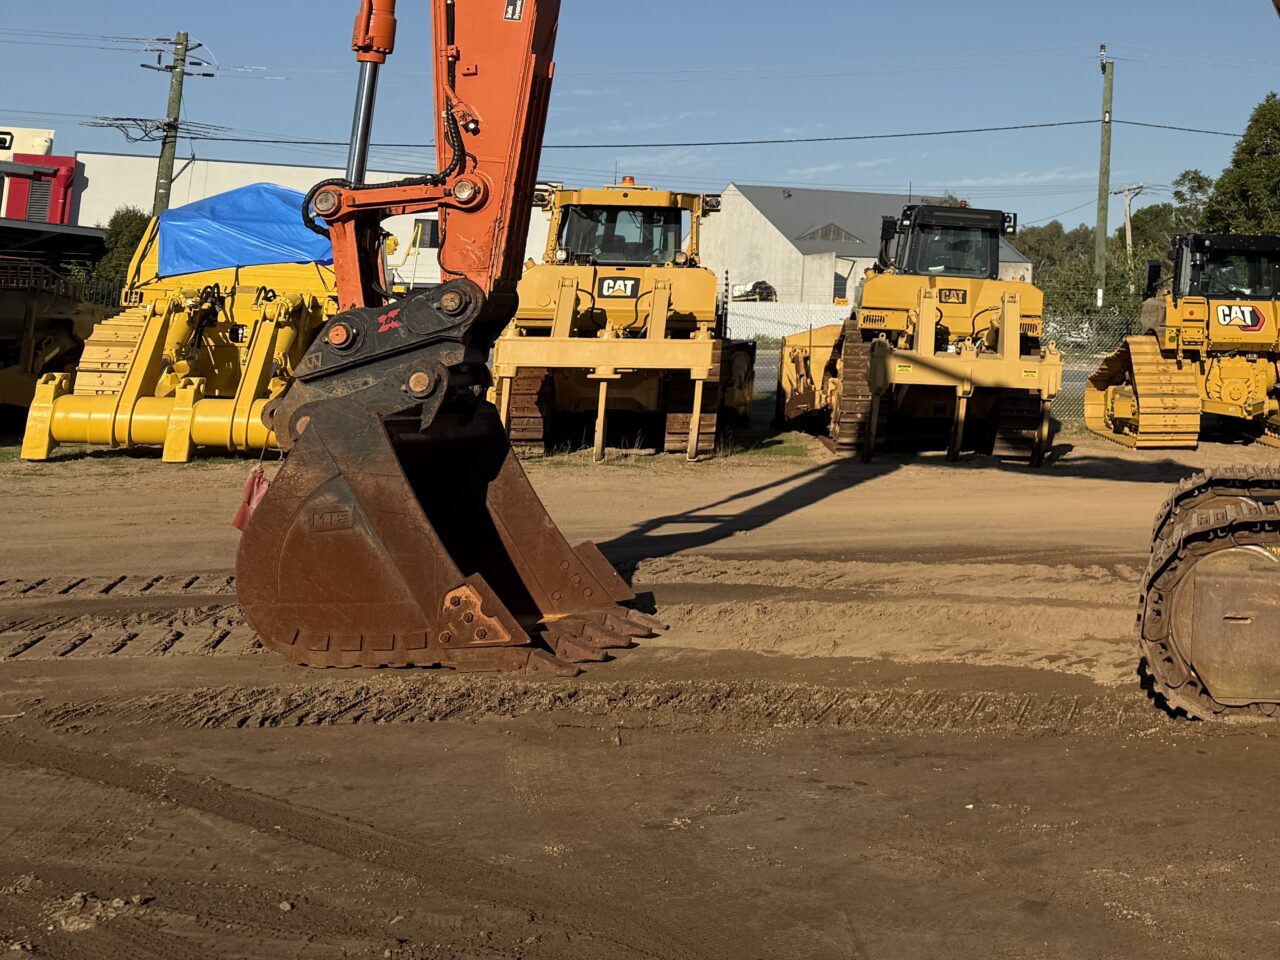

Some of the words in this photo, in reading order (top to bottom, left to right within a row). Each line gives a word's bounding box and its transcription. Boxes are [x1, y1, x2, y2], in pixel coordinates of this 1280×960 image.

[602, 279, 635, 296] CAT
[940, 289, 965, 304] CAT
[1217, 305, 1253, 326] CAT
